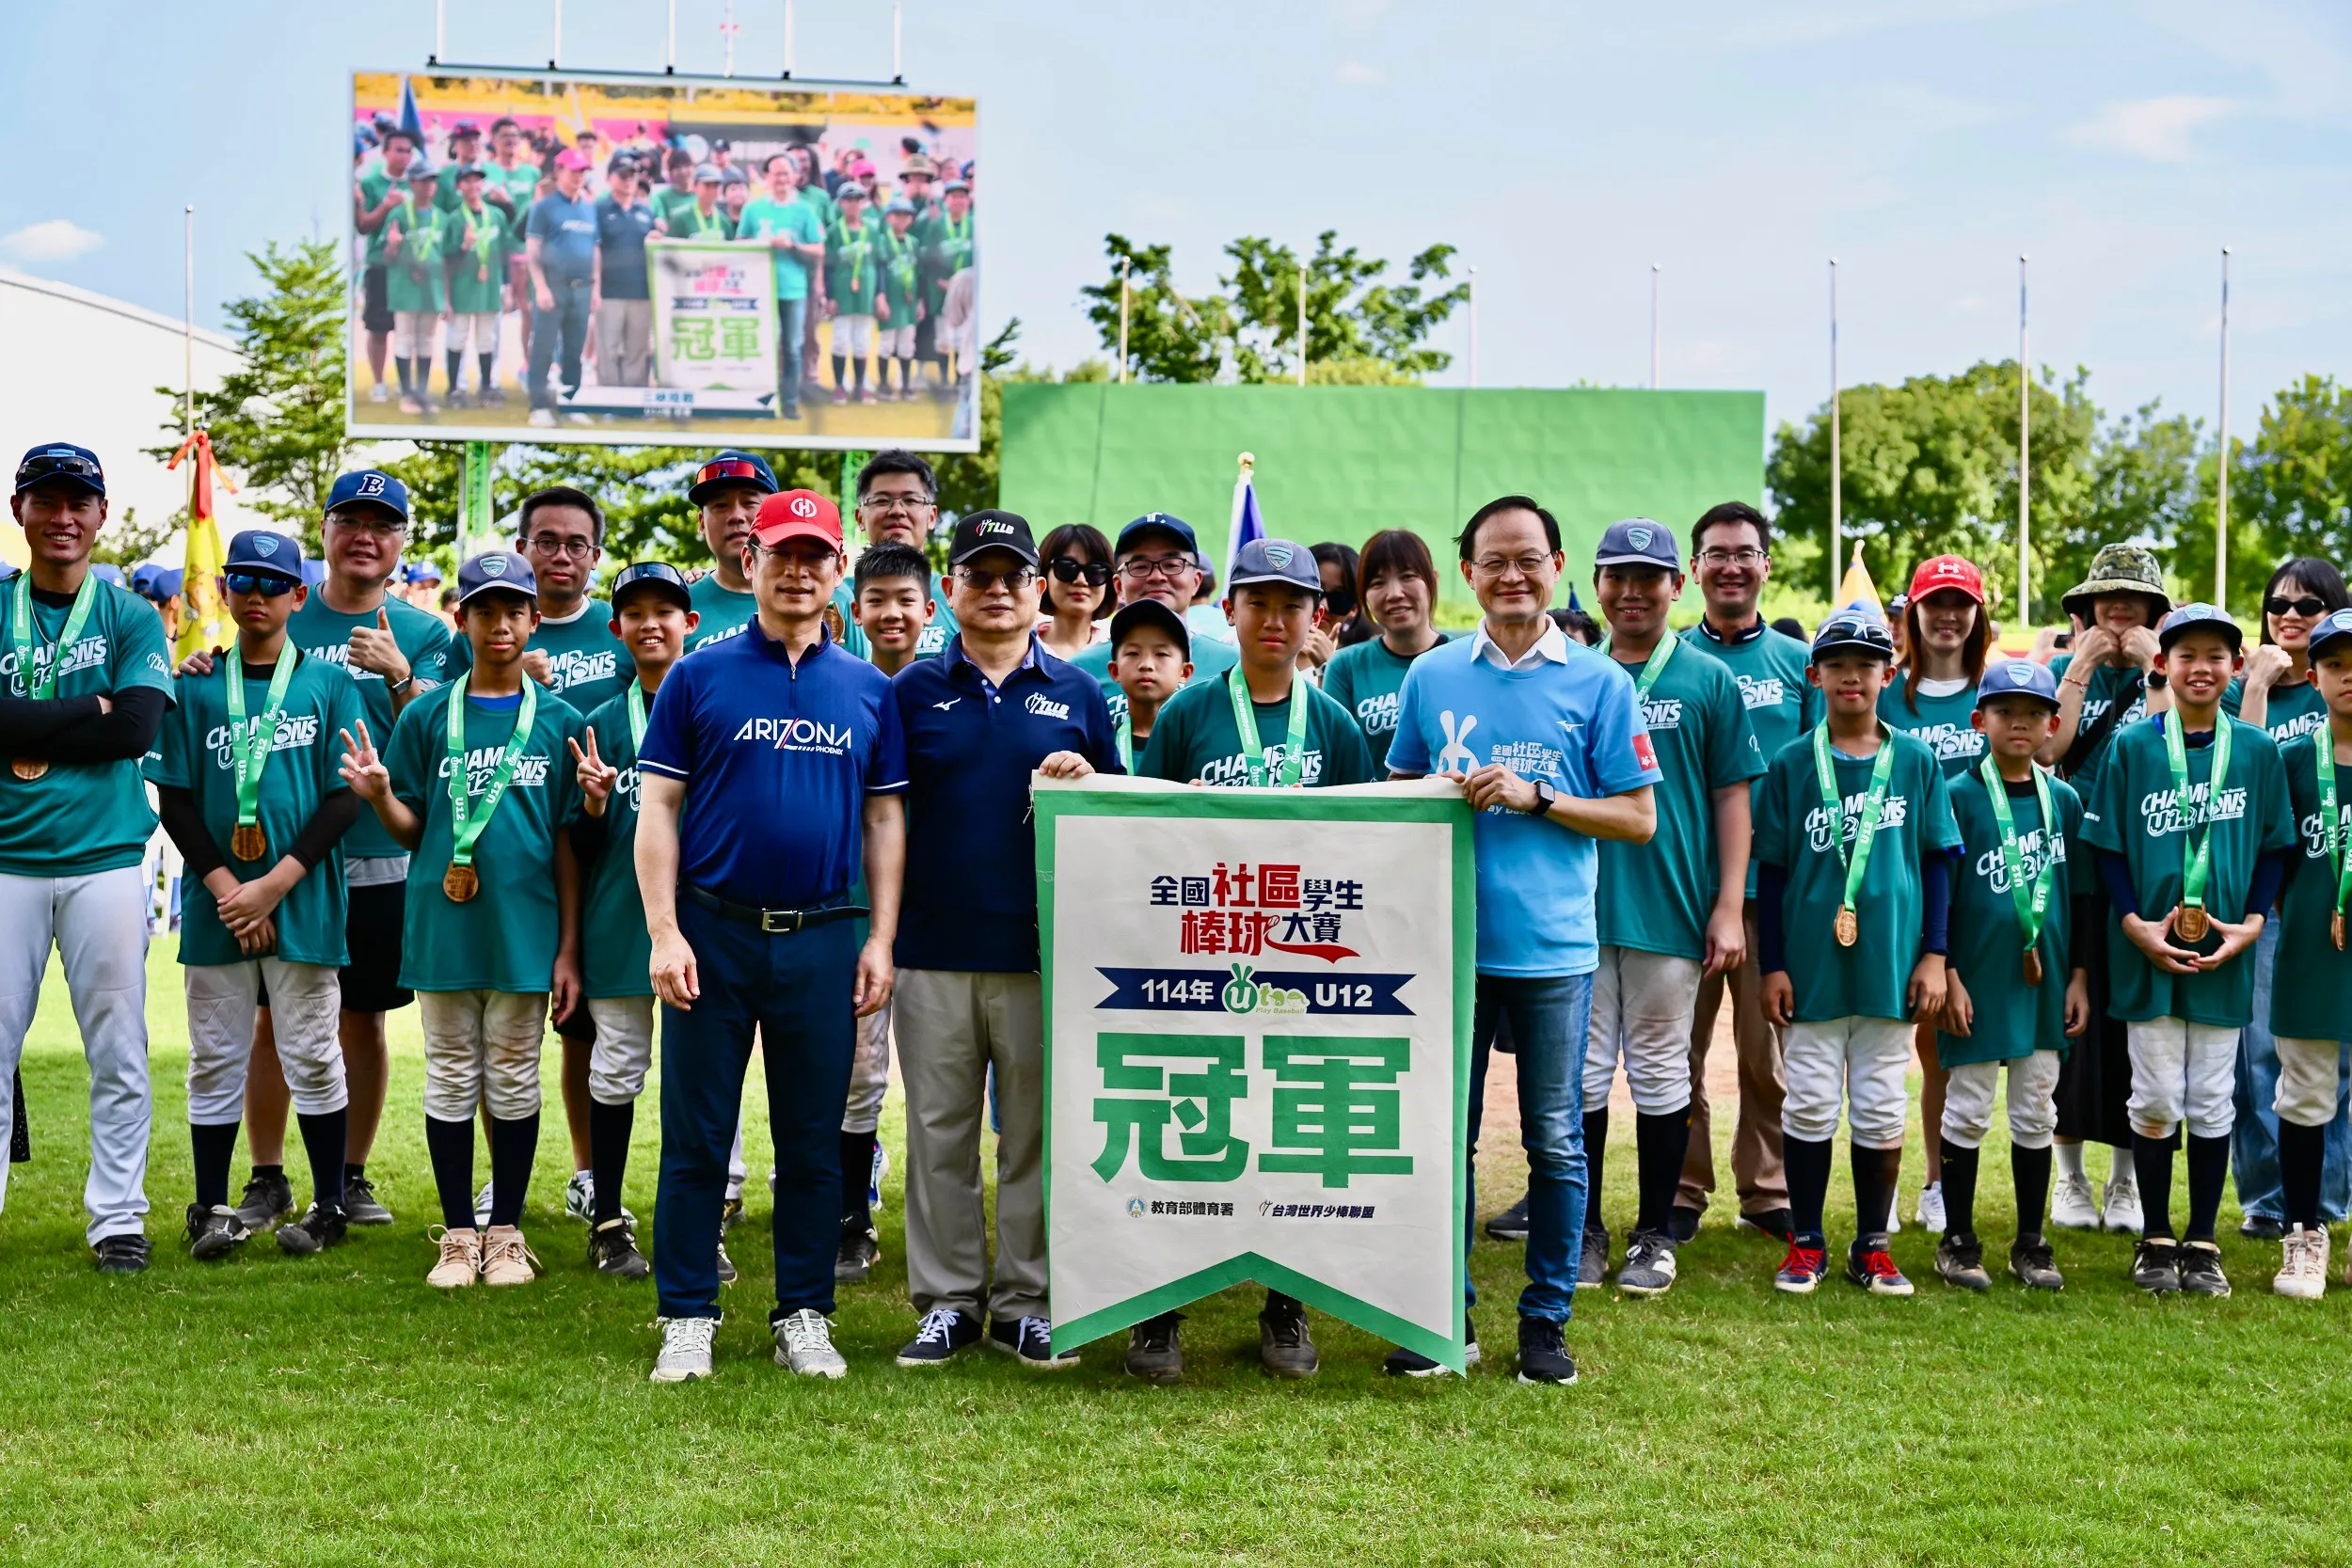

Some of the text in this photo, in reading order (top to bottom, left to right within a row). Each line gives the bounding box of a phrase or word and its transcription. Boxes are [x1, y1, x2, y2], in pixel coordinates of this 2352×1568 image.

[671, 317, 763, 361] 冠軍
[357, 473, 385, 497] E
[987, 521, 1015, 535] TLLB
[734, 718, 851, 750] ARIZONA
[253, 737, 268, 760] U12
[816, 745, 843, 755] PHOENIX
[485, 781, 503, 804] U12
[454, 797, 466, 821] U12
[1860, 821, 1873, 844] U12
[2327, 825, 2336, 849] U12
[1150, 863, 1363, 911] 全國社區學生
[2011, 863, 2024, 888] U12
[1181, 910, 1343, 956] 棒球大賽
[1141, 979, 1215, 1005] 114年
[1315, 984, 1374, 1007] U12
[1090, 1032, 1414, 1189] 冠軍
[1151, 1200, 1234, 1217] 教育部體育署
[1272, 1204, 1375, 1219] 台灣世界少棒聯盟
